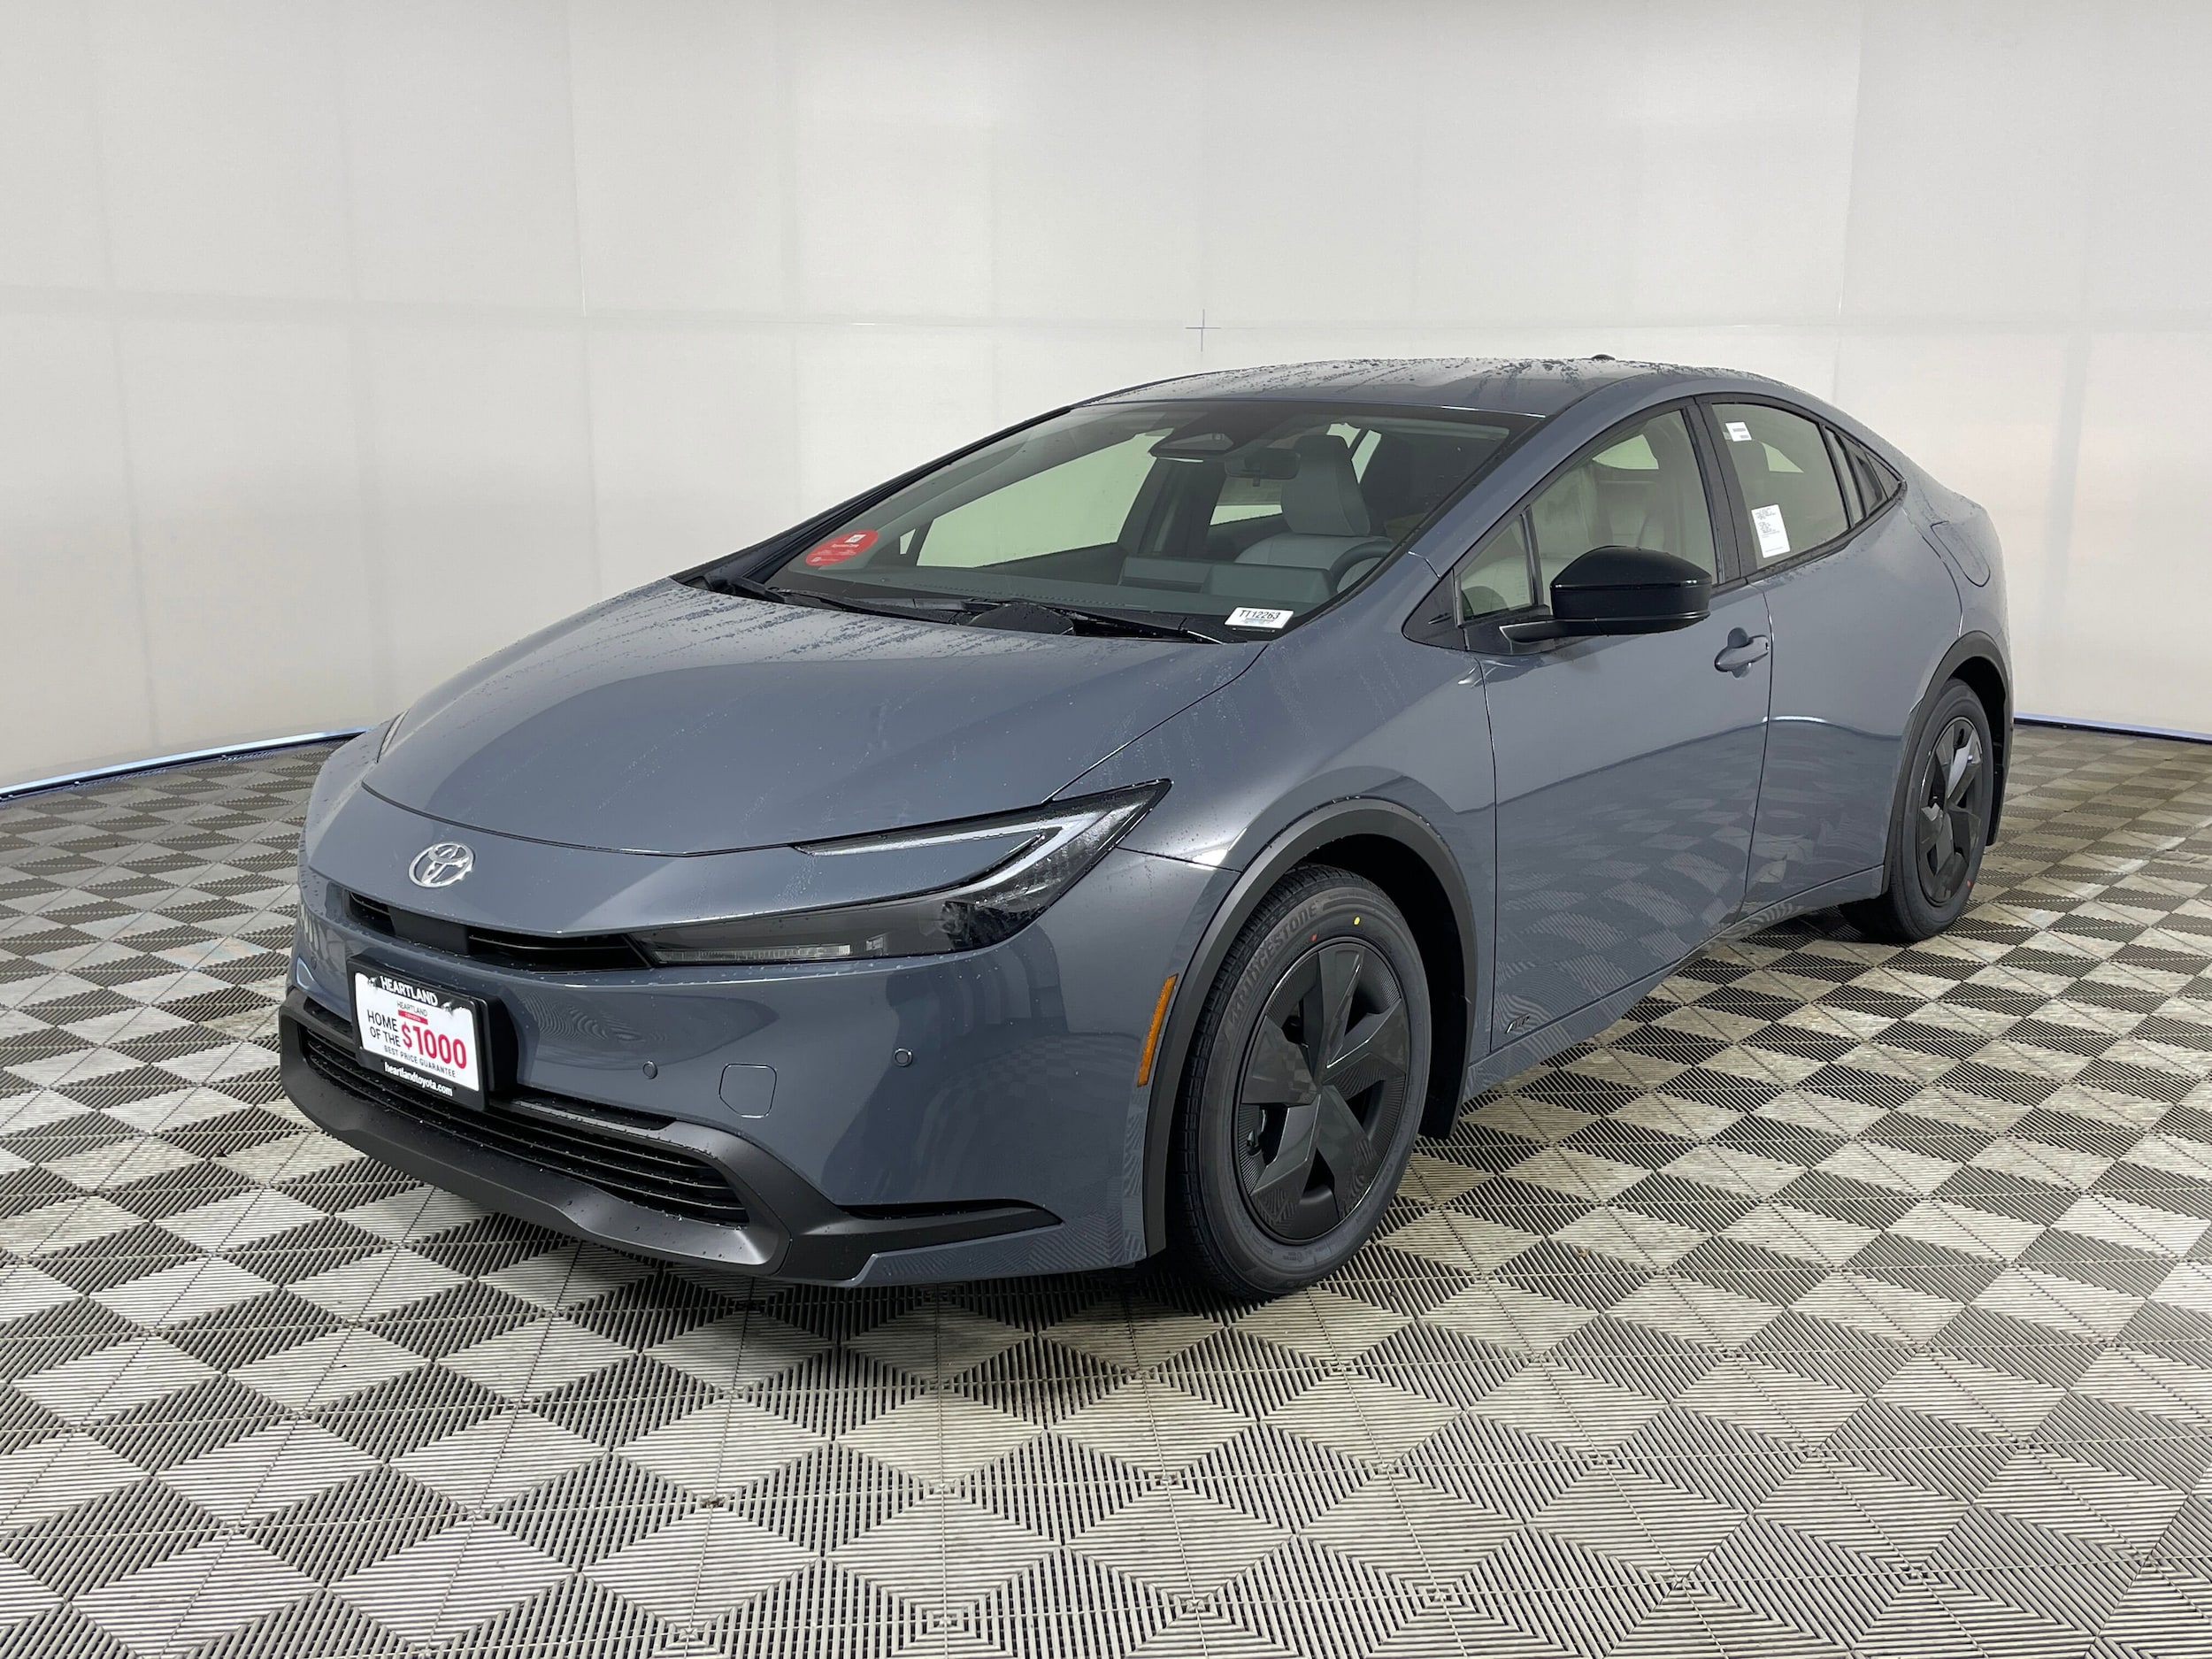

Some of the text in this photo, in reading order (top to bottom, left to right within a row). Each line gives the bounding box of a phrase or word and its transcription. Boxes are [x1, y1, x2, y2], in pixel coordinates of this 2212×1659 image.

[380, 976, 438, 1006] HEARTLAND
[366, 1009, 398, 1033] HOME
[397, 1001, 427, 1017] HEARTLAND
[370, 1026, 402, 1048] OF THE
[401, 1021, 467, 1070] $1000
[384, 1045, 457, 1079] BEST PRICE GUARANTEE
[384, 1062, 454, 1097] heartlandtoyota.com
